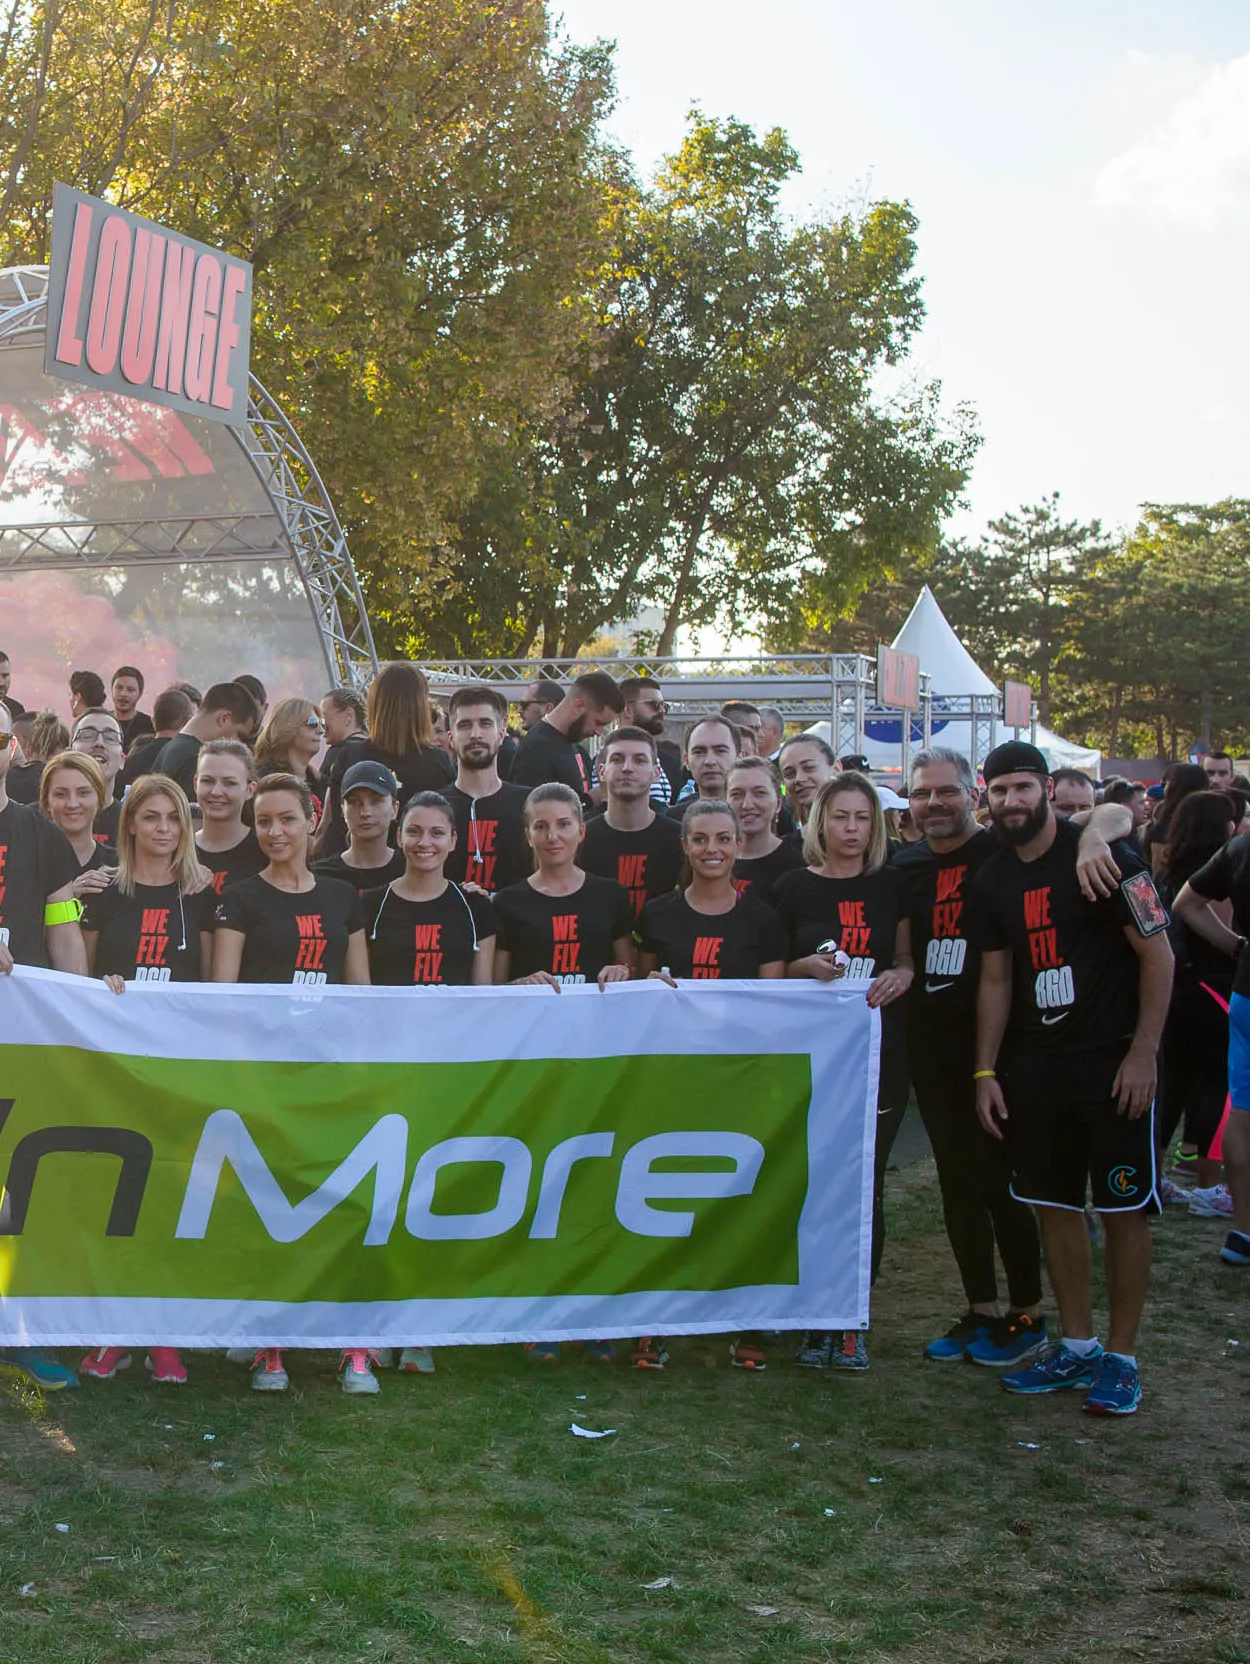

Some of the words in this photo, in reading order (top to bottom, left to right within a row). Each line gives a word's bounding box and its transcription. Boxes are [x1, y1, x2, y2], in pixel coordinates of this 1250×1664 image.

[55, 202, 246, 411] LOUNGE
[467, 820, 499, 852] WE
[618, 854, 648, 888] WE
[140, 909, 171, 934] WE
[838, 901, 867, 928] WE
[1023, 886, 1053, 931] WE
[295, 914, 325, 938] WE
[415, 924, 442, 951] WE
[552, 914, 579, 941] WE
[135, 935, 170, 965] FLY.
[294, 939, 328, 969] FLY.
[692, 937, 724, 965] WE
[839, 927, 872, 956] FLY.
[413, 952, 444, 982] FLY.
[551, 942, 581, 973] FLY.
[925, 938, 968, 976] BGD
[1035, 964, 1076, 1009] BGD
[174, 1108, 766, 1247] More
